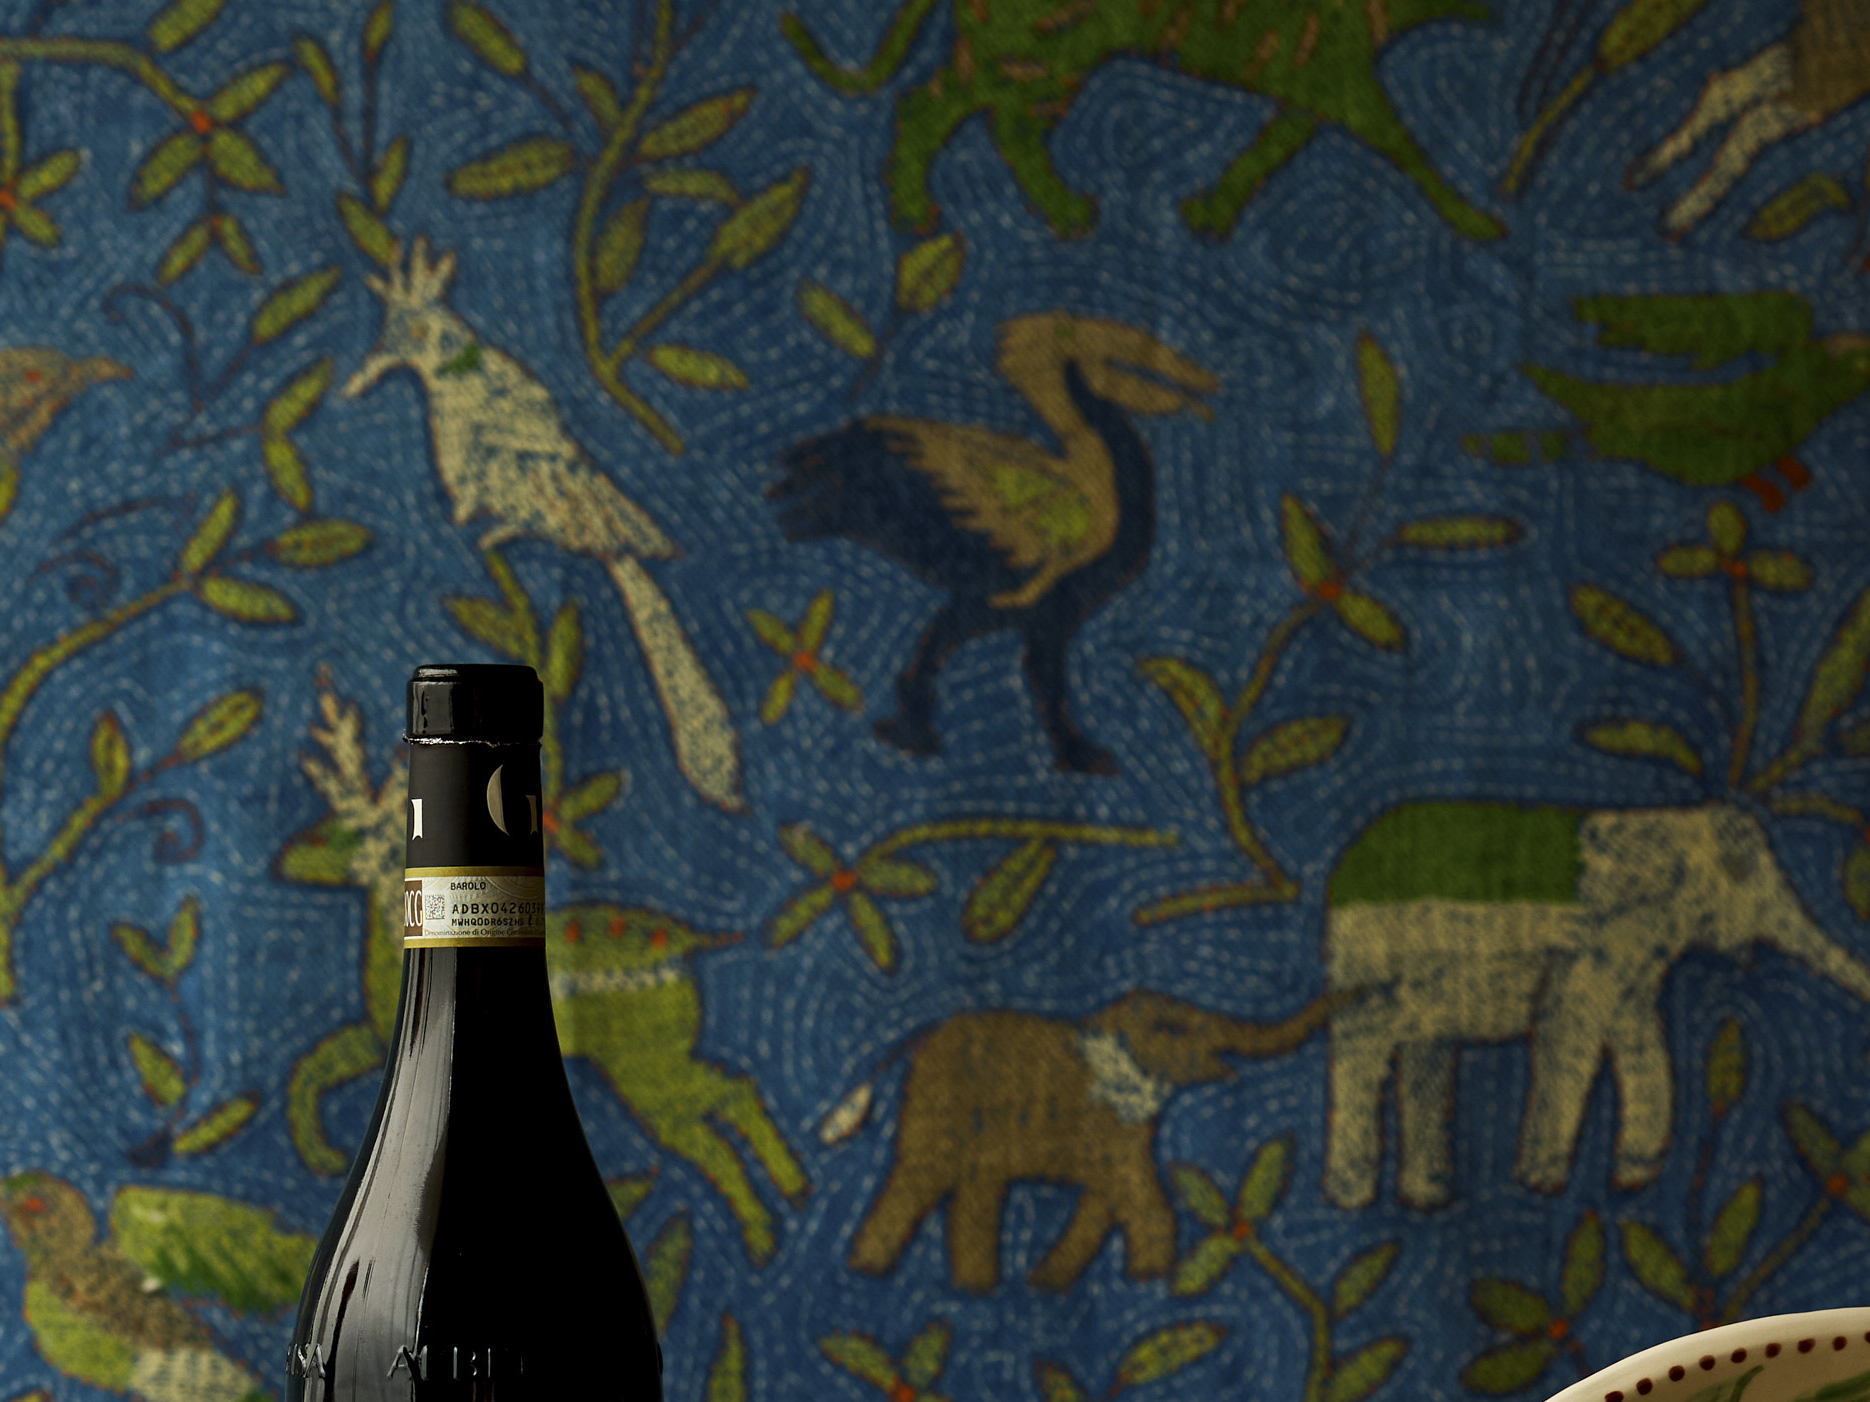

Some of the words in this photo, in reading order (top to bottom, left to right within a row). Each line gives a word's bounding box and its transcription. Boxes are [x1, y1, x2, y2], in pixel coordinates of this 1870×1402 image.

[450, 881, 487, 891] BAROLO
[472, 928, 480, 936] di
[481, 928, 505, 938] Origine
